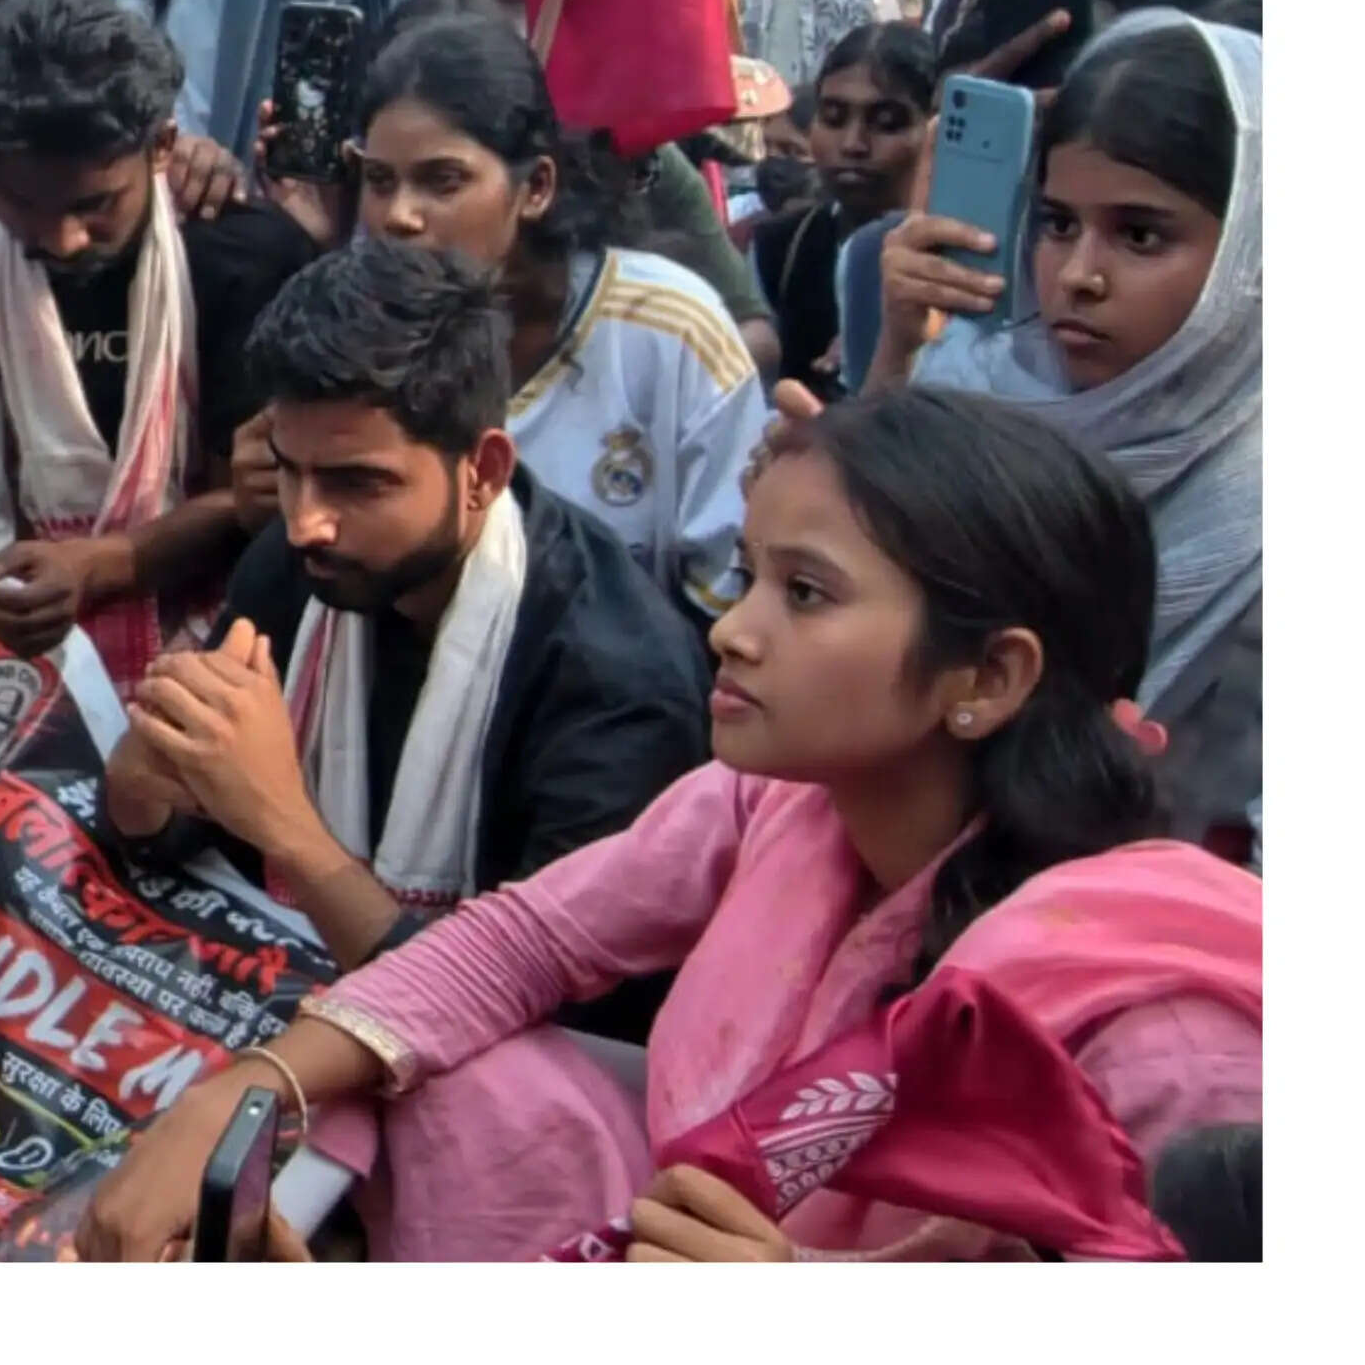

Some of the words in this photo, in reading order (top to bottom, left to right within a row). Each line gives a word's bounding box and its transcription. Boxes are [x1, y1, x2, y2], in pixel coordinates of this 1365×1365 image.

[107, 943, 176, 980] पराध
[1, 1050, 63, 1100] सुरक्षा
[59, 1081, 88, 1113] के
